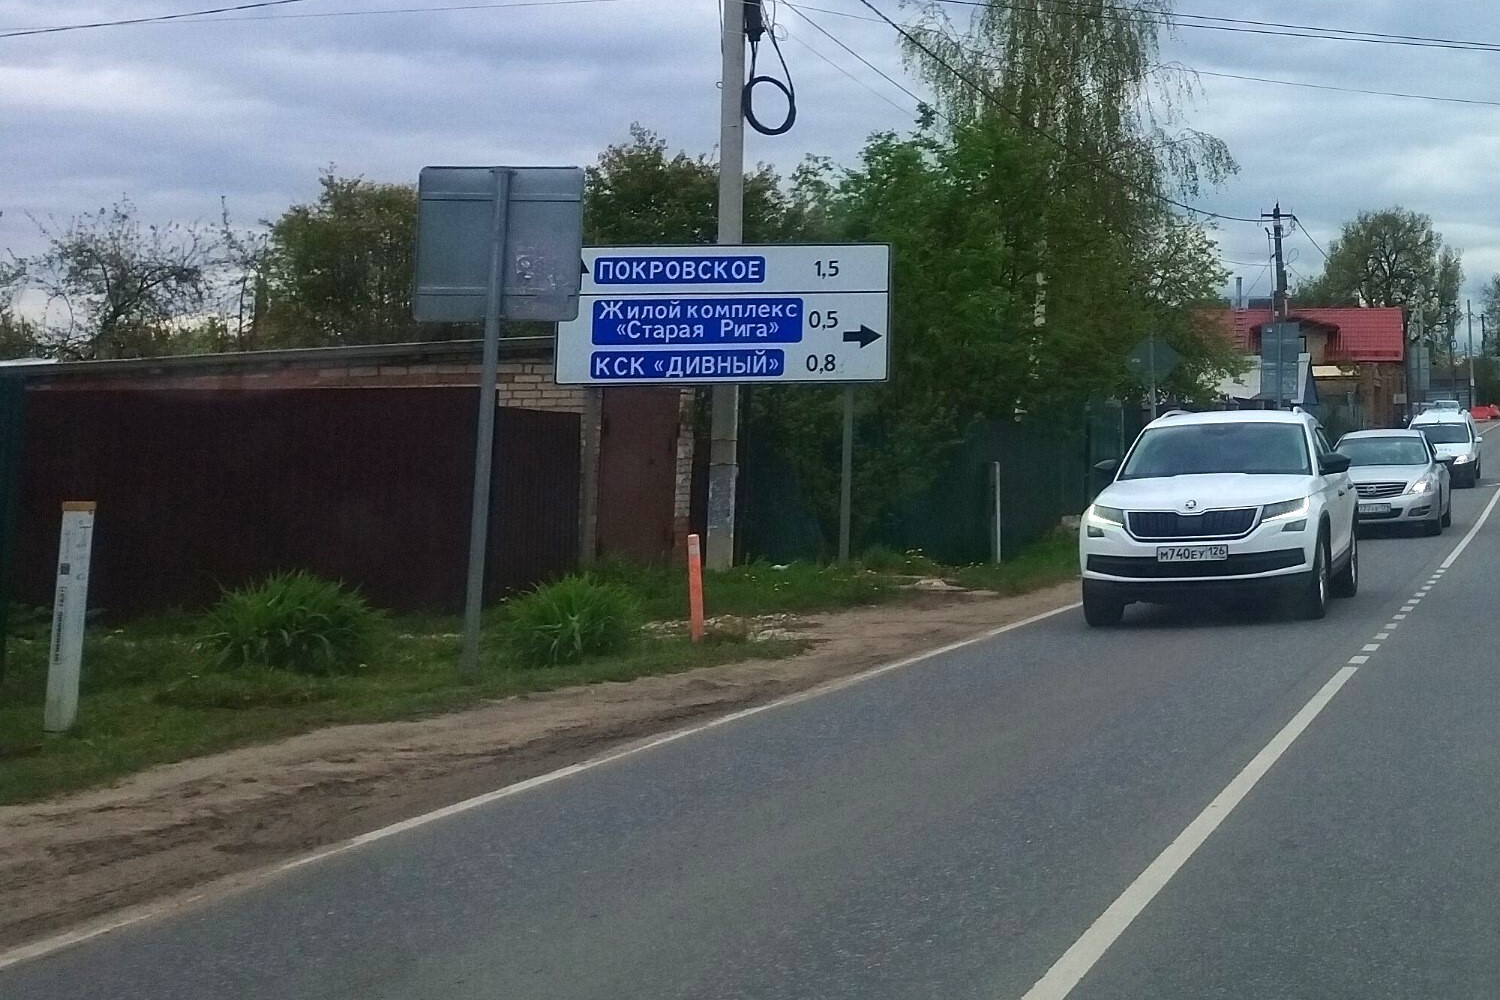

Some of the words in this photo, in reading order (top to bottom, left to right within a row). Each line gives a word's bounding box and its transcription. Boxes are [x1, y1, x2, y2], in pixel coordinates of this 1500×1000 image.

[598, 259, 761, 281] ПОКРОВСКОЕ
[813, 259, 840, 279] 1,5
[598, 300, 682, 320] Жилой
[687, 301, 798, 320] комплекс
[808, 310, 839, 331] 0,5
[616, 319, 705, 343] «Старая
[720, 319, 780, 340] Рига»
[595, 356, 645, 377] КСК
[654, 350, 779, 378] «ДИВНЫЙ»
[806, 353, 837, 375] 0,8
[1160, 548, 1205, 560] М740ЕУ
[1208, 546, 1226, 556] 126
